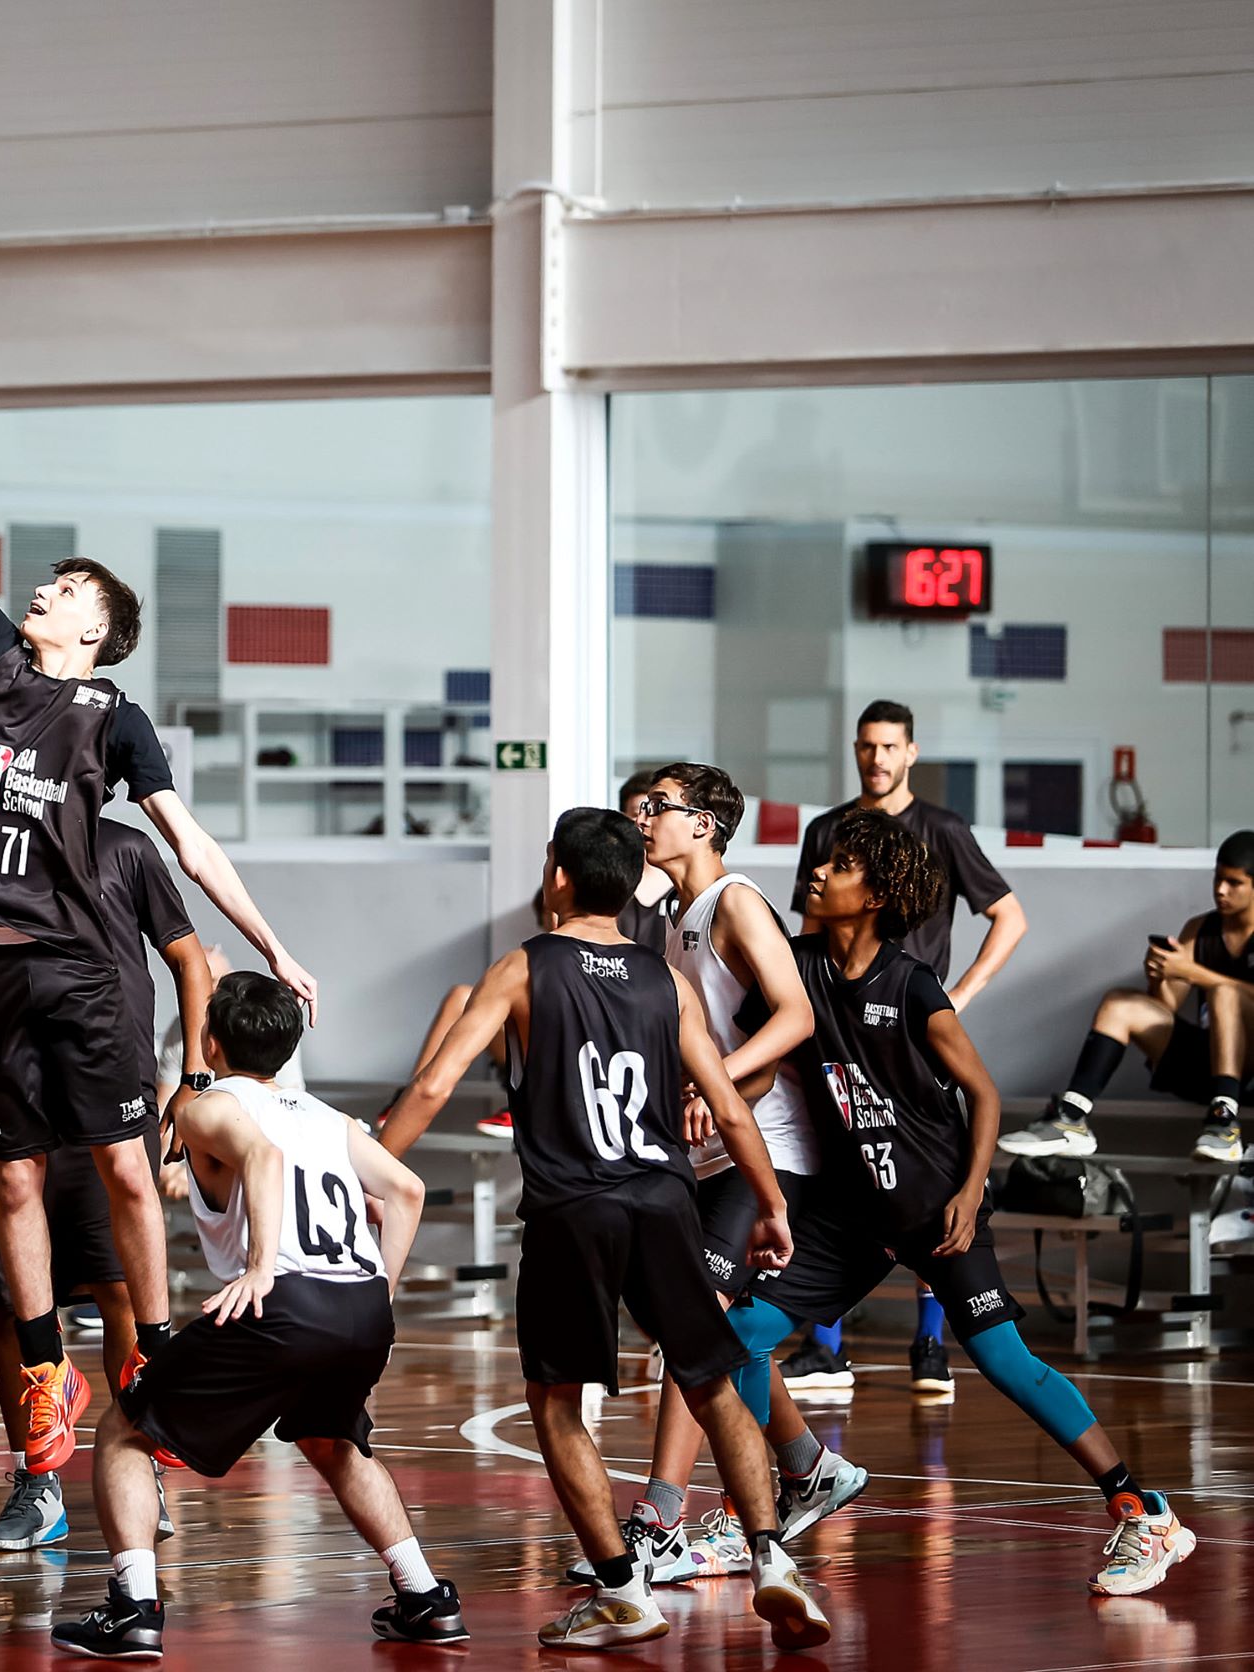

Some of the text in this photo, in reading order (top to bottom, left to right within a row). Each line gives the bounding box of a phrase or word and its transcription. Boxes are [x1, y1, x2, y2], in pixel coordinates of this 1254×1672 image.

[5, 766, 68, 804] Basketball
[2, 790, 44, 820] School
[1, 826, 31, 876] 71
[580, 950, 628, 971] THINK
[581, 962, 629, 980] SPORTS
[578, 1040, 669, 1162] 62
[856, 1106, 897, 1129] School
[967, 1288, 1001, 1309] THINK
[972, 1299, 1004, 1317] SPORTS
